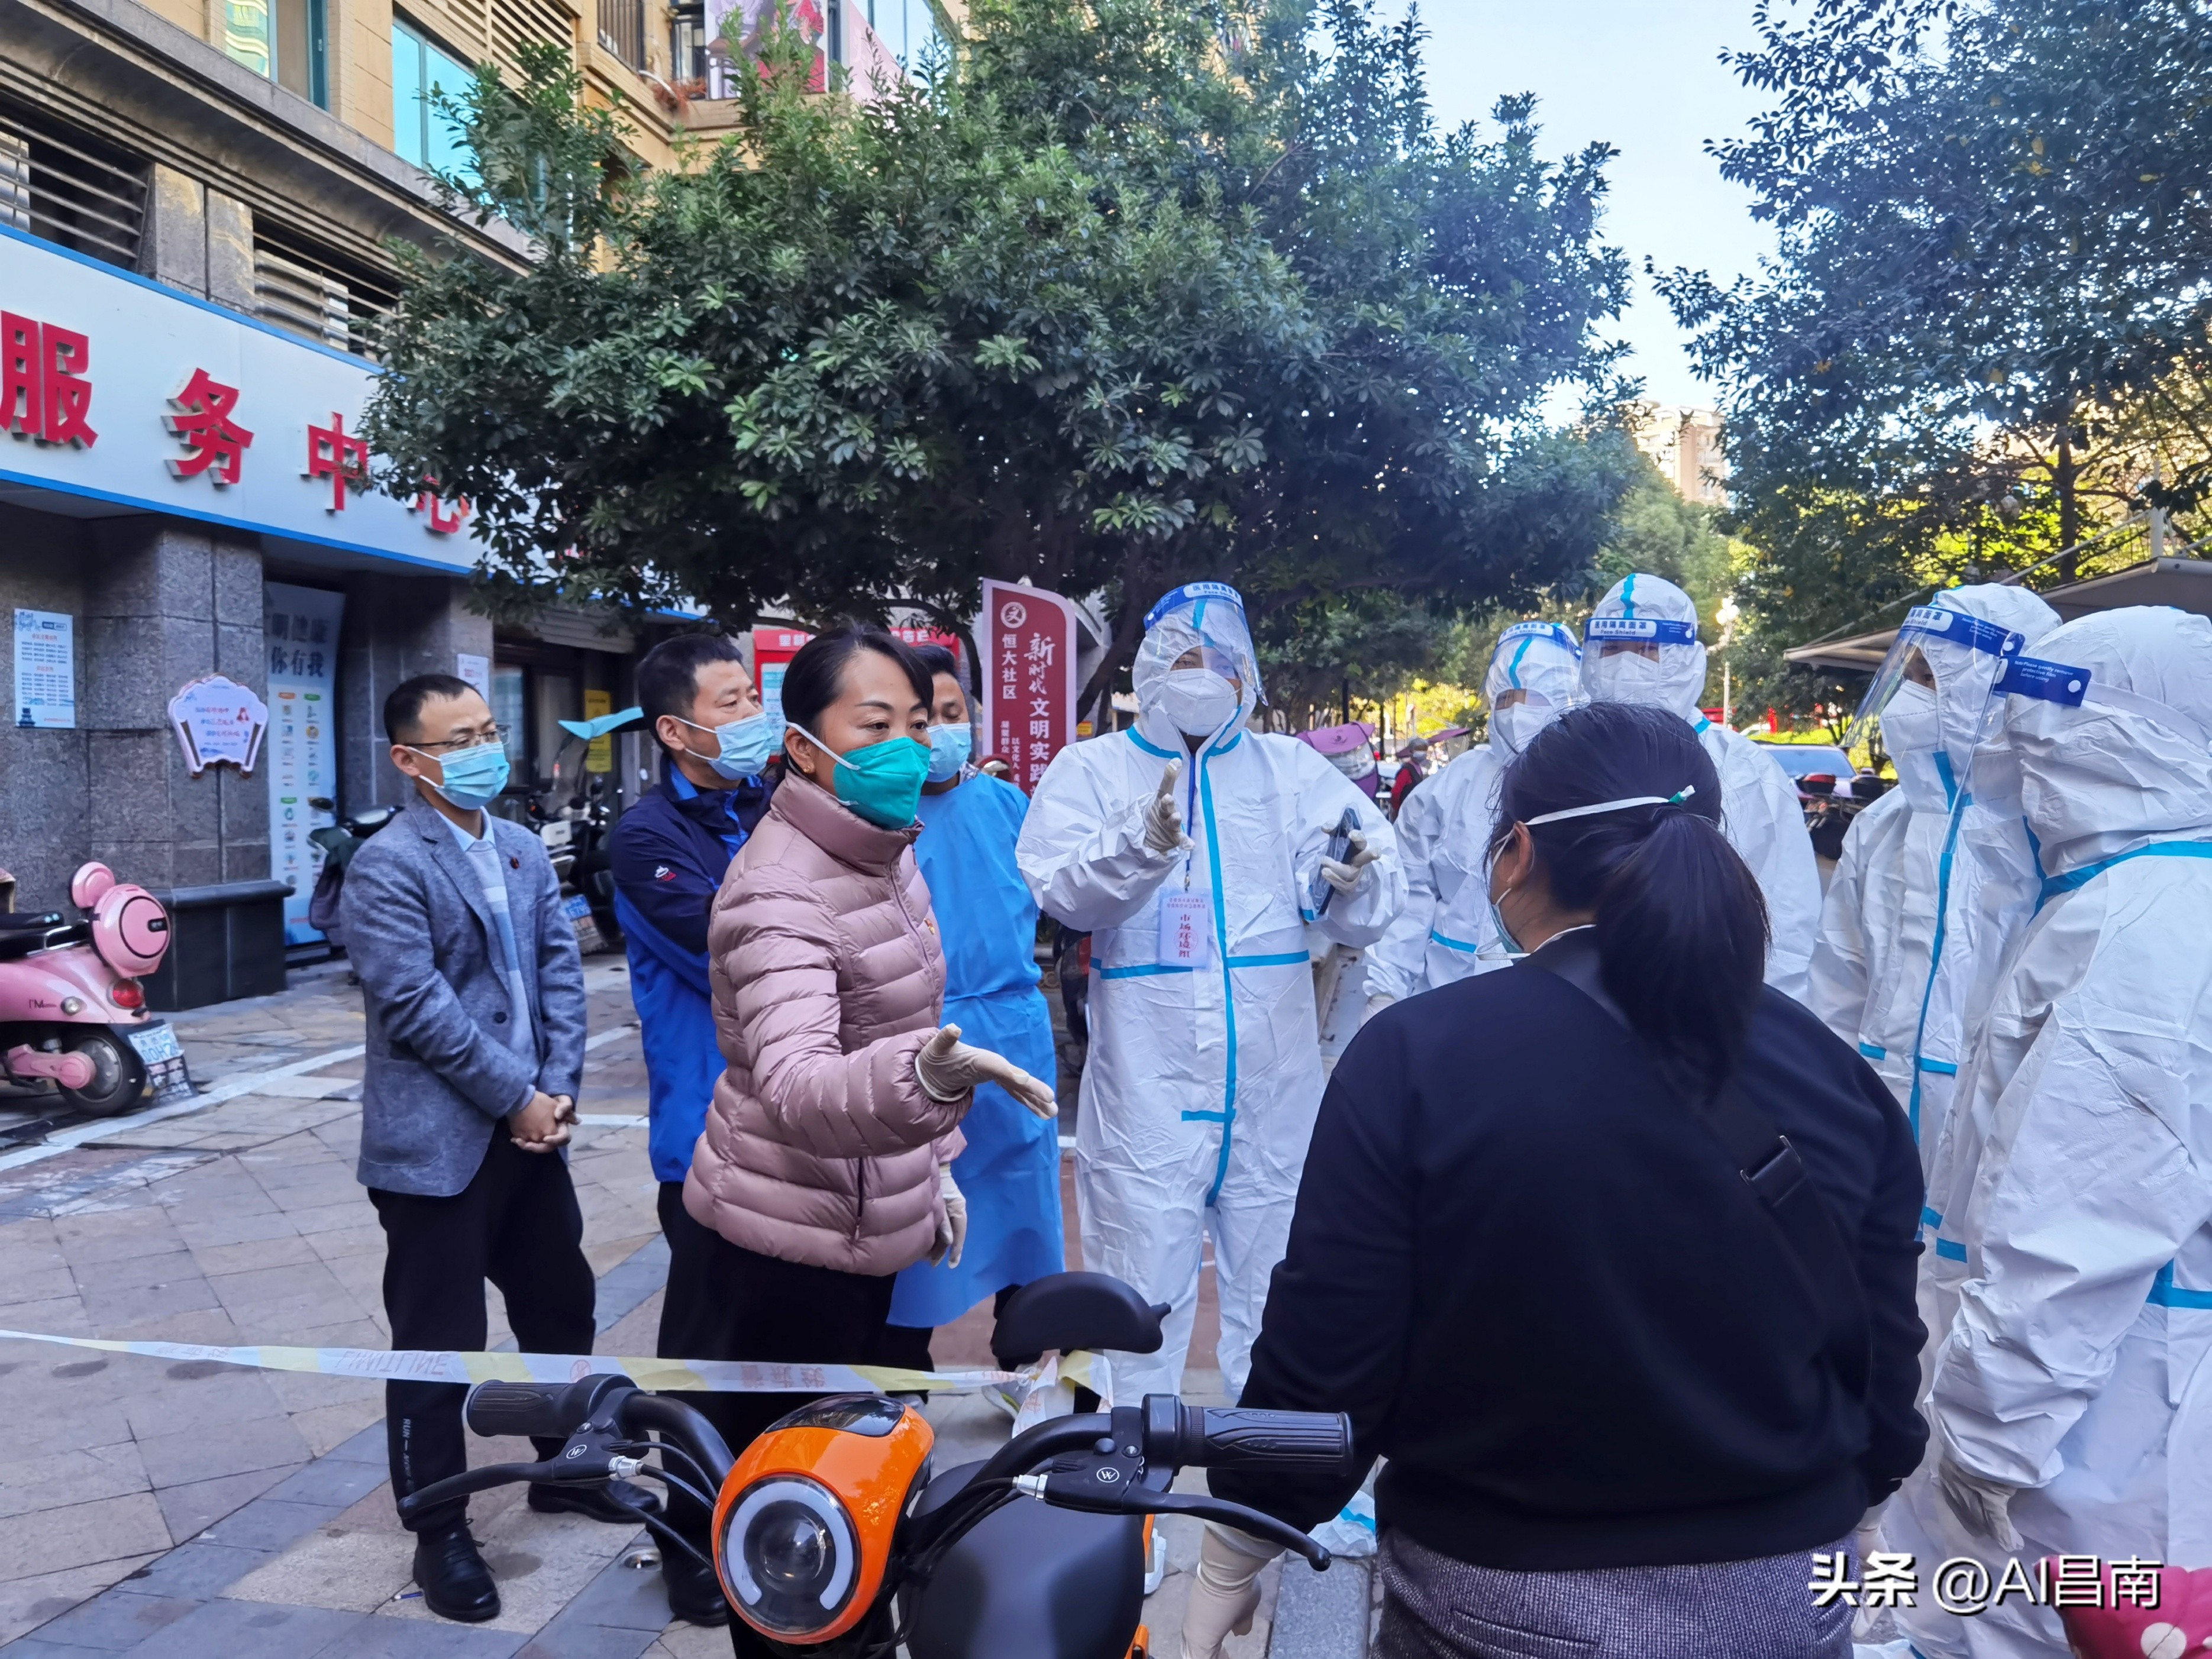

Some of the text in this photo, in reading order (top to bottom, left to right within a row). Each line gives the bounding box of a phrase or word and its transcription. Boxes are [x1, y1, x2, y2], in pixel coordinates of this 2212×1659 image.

[1002, 633, 1018, 699] 恒大社区
[1023, 632, 1055, 798] 新时代文明实践
